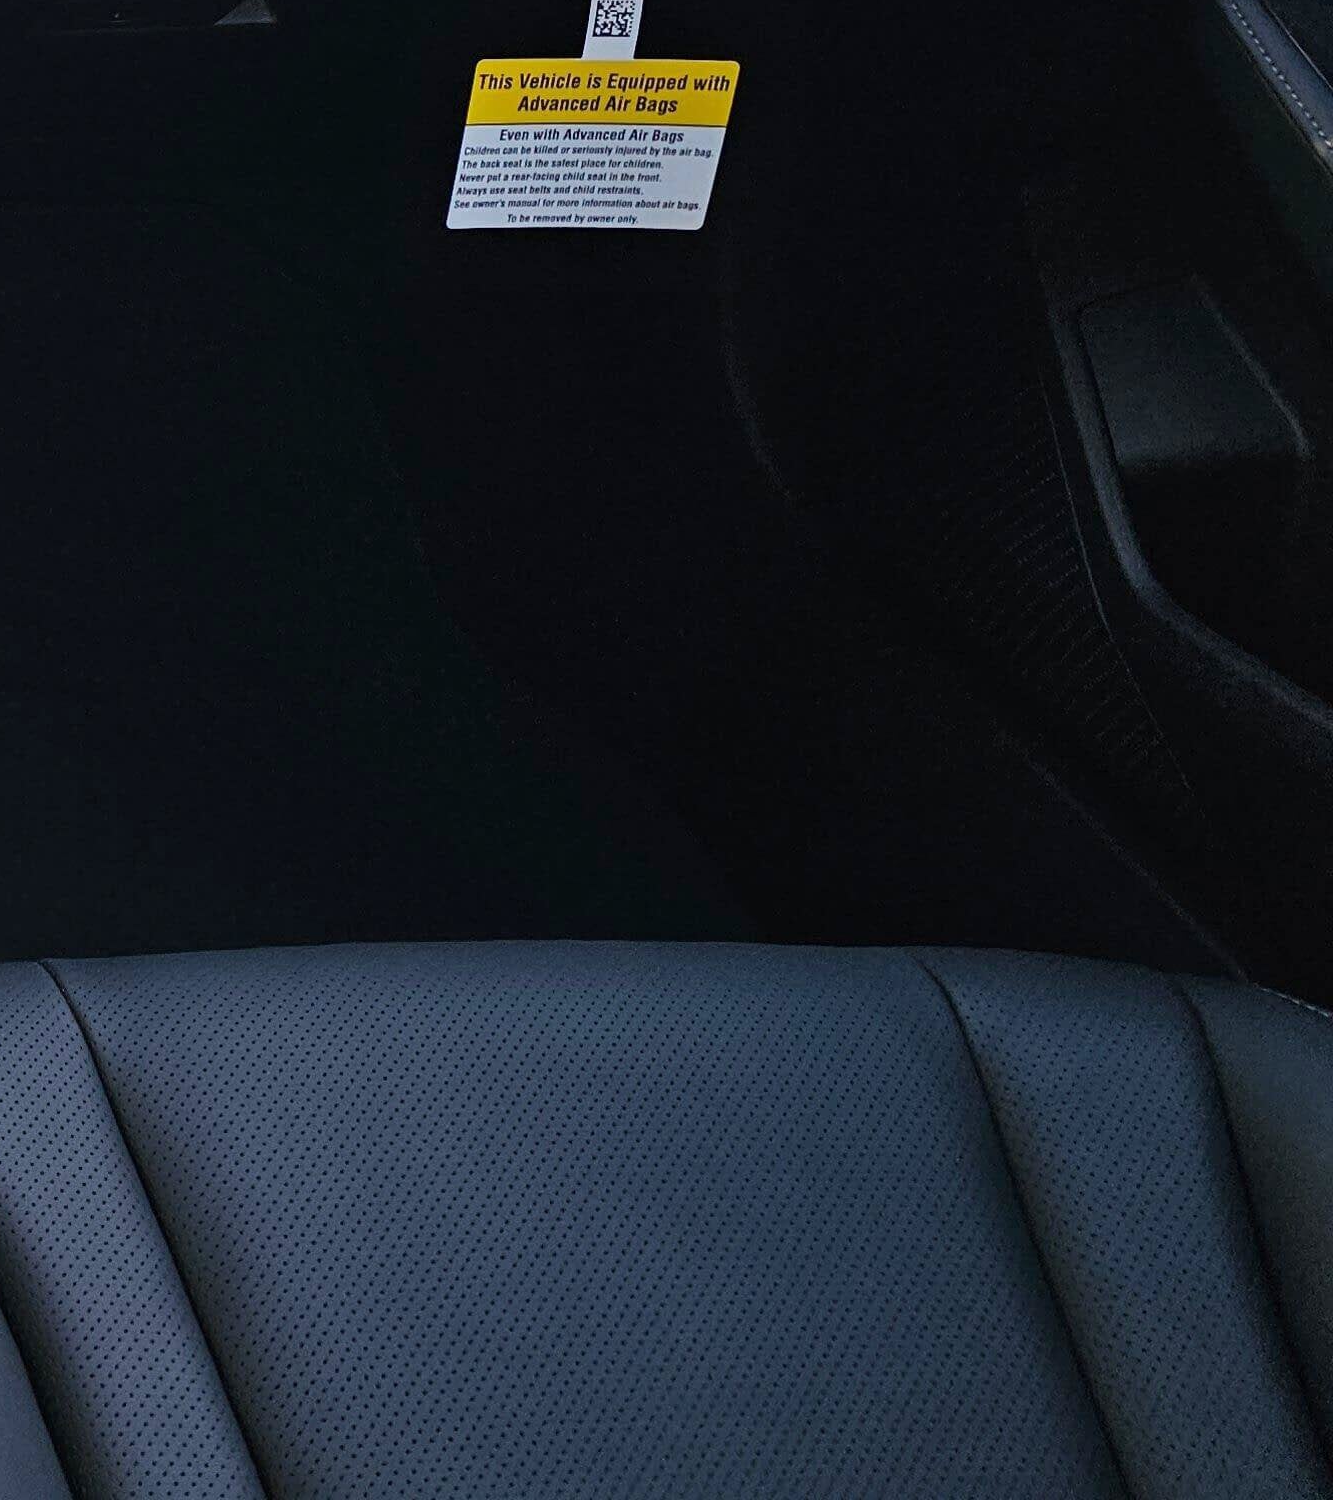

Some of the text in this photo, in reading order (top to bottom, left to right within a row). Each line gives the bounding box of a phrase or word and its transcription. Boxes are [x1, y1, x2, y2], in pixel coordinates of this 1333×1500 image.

[479, 73, 730, 92] This Vehicle is Equipped with
[518, 95, 678, 115] Advanced Air Bags
[500, 128, 685, 144] Even with Advanced Air Bags
[464, 147, 500, 156] Children
[502, 147, 518, 155] can
[520, 146, 532, 154] be
[533, 145, 559, 154] killed
[572, 145, 613, 156] seriously
[615, 146, 648, 157] injured
[649, 147, 660, 157] by
[662, 147, 677, 156] the
[679, 148, 692, 156] air
[694, 148, 714, 159] bag.
[462, 159, 664, 169] The back seat is the safest place for children.
[459, 172, 662, 183] Never put rear-facing child seat in the front.
[456, 185, 644, 197] Always use seat belts and child restraints.
[454, 198, 701, 211] See owner's manual for more information about air bags.
[507, 213, 638, 224] To be removed by owner only.
